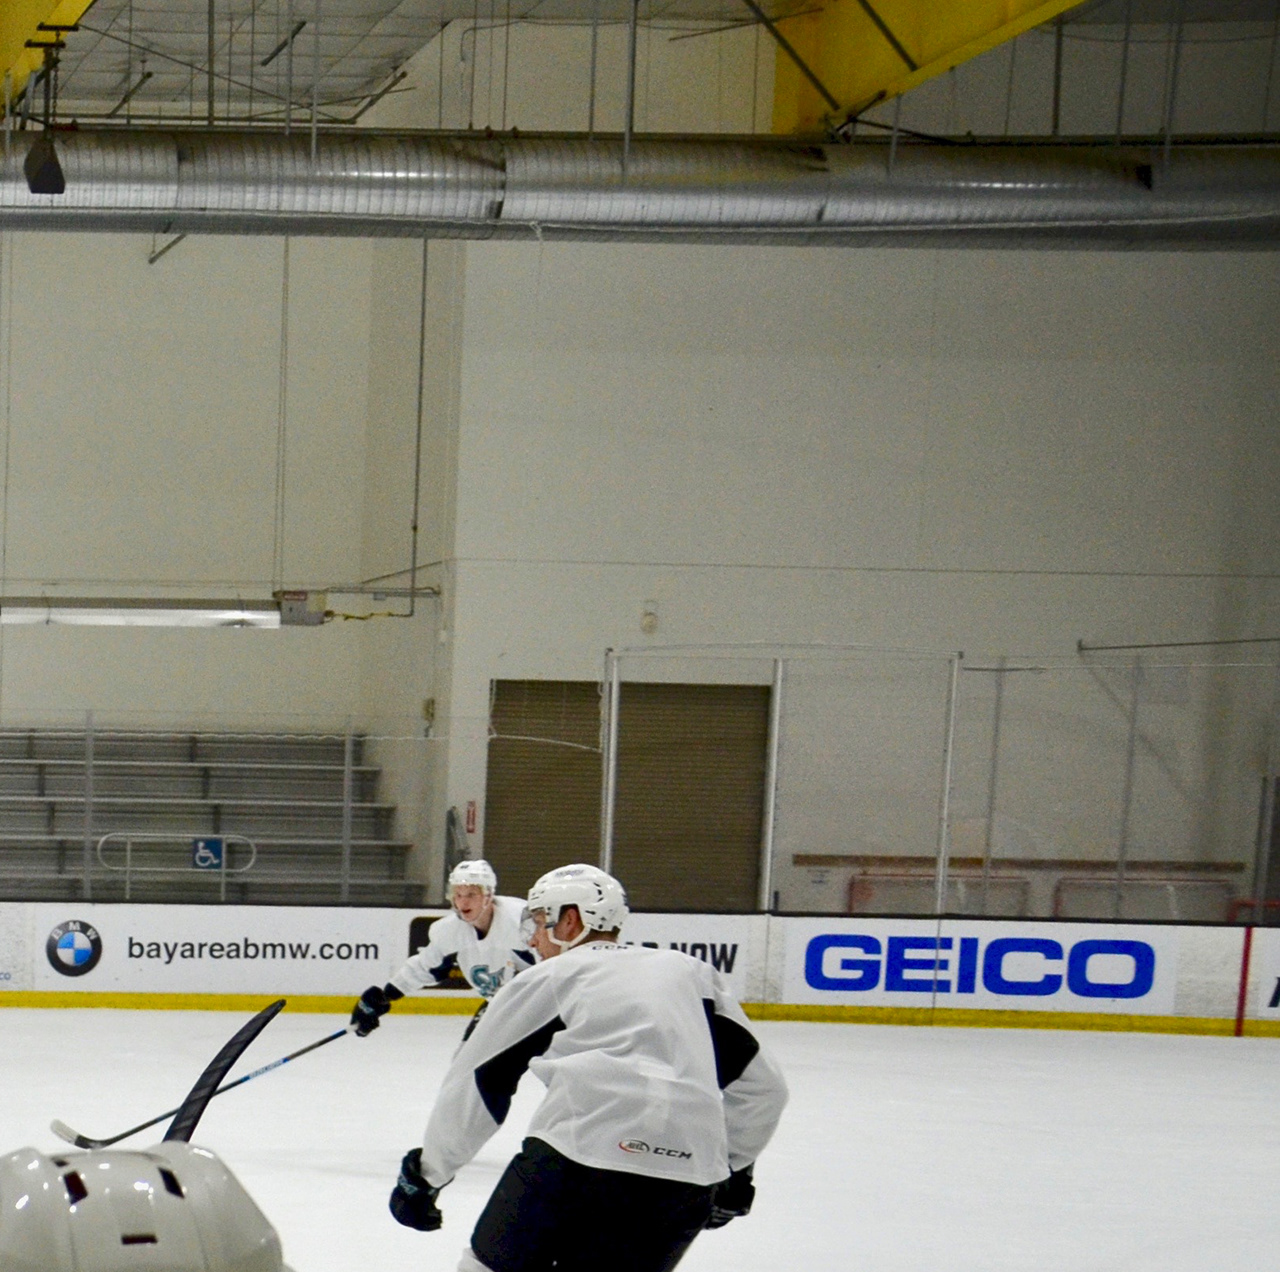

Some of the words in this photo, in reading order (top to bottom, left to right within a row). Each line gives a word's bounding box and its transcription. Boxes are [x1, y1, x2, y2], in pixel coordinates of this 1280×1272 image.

[50, 921, 98, 940] BMW
[128, 937, 379, 964] bayareabmw.com
[670, 942, 738, 973] OW
[804, 934, 1155, 999] GEICO
[653, 1147, 693, 1159] CCM
